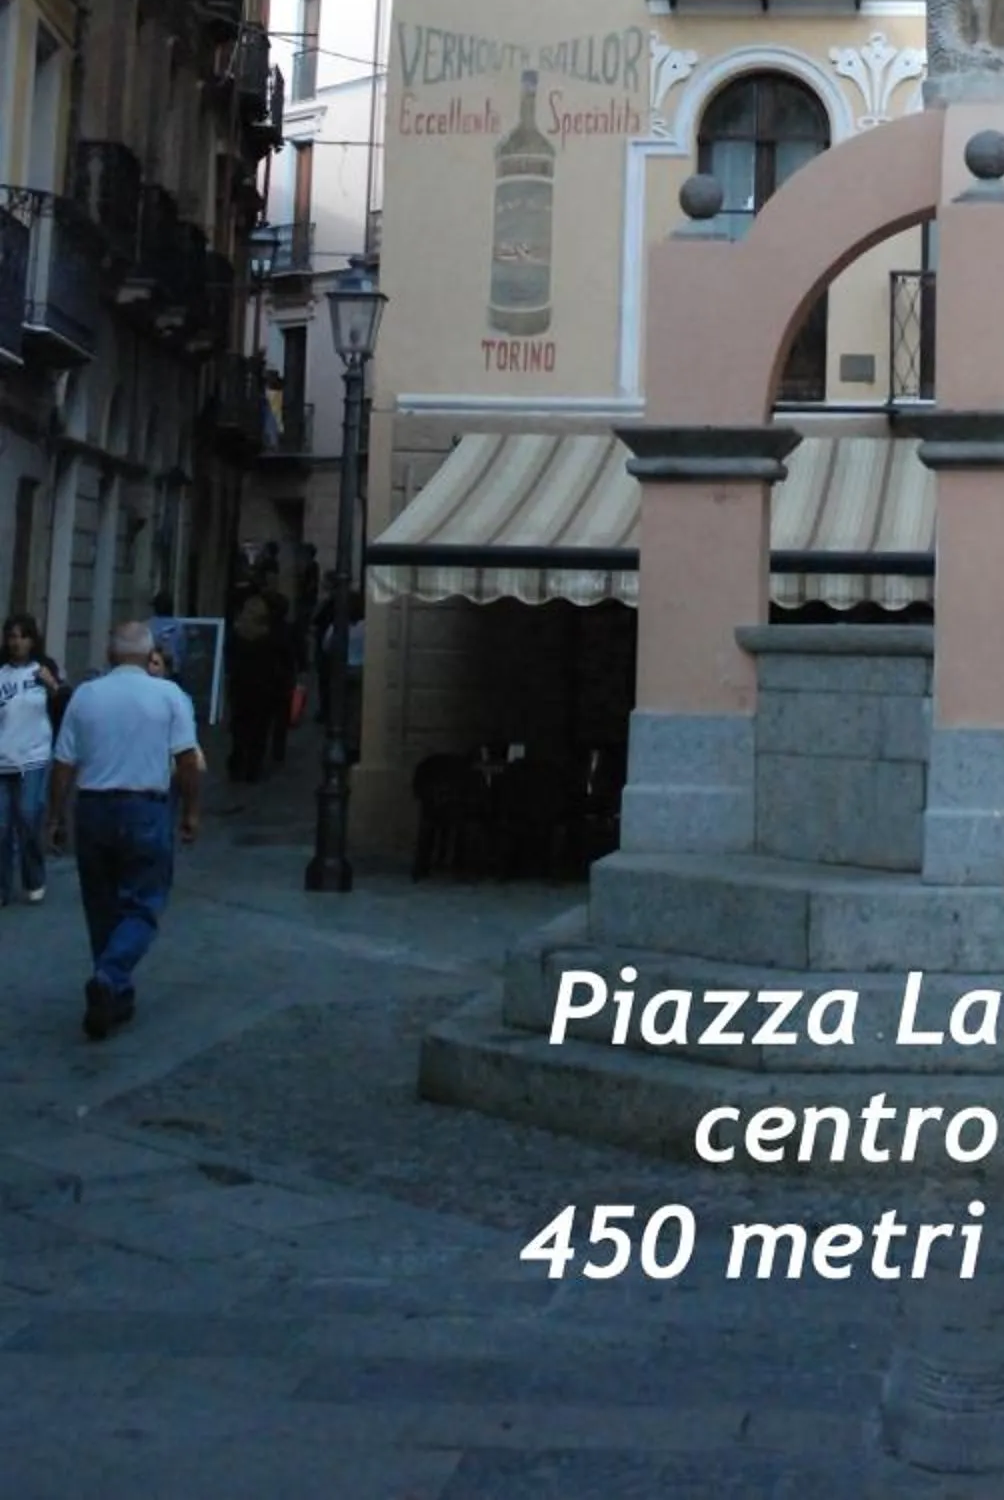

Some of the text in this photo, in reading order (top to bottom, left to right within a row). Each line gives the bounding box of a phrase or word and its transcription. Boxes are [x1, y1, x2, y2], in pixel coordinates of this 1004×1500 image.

[398, 21, 643, 93] VERMOUTH BALLOR
[481, 340, 556, 372] TORINO
